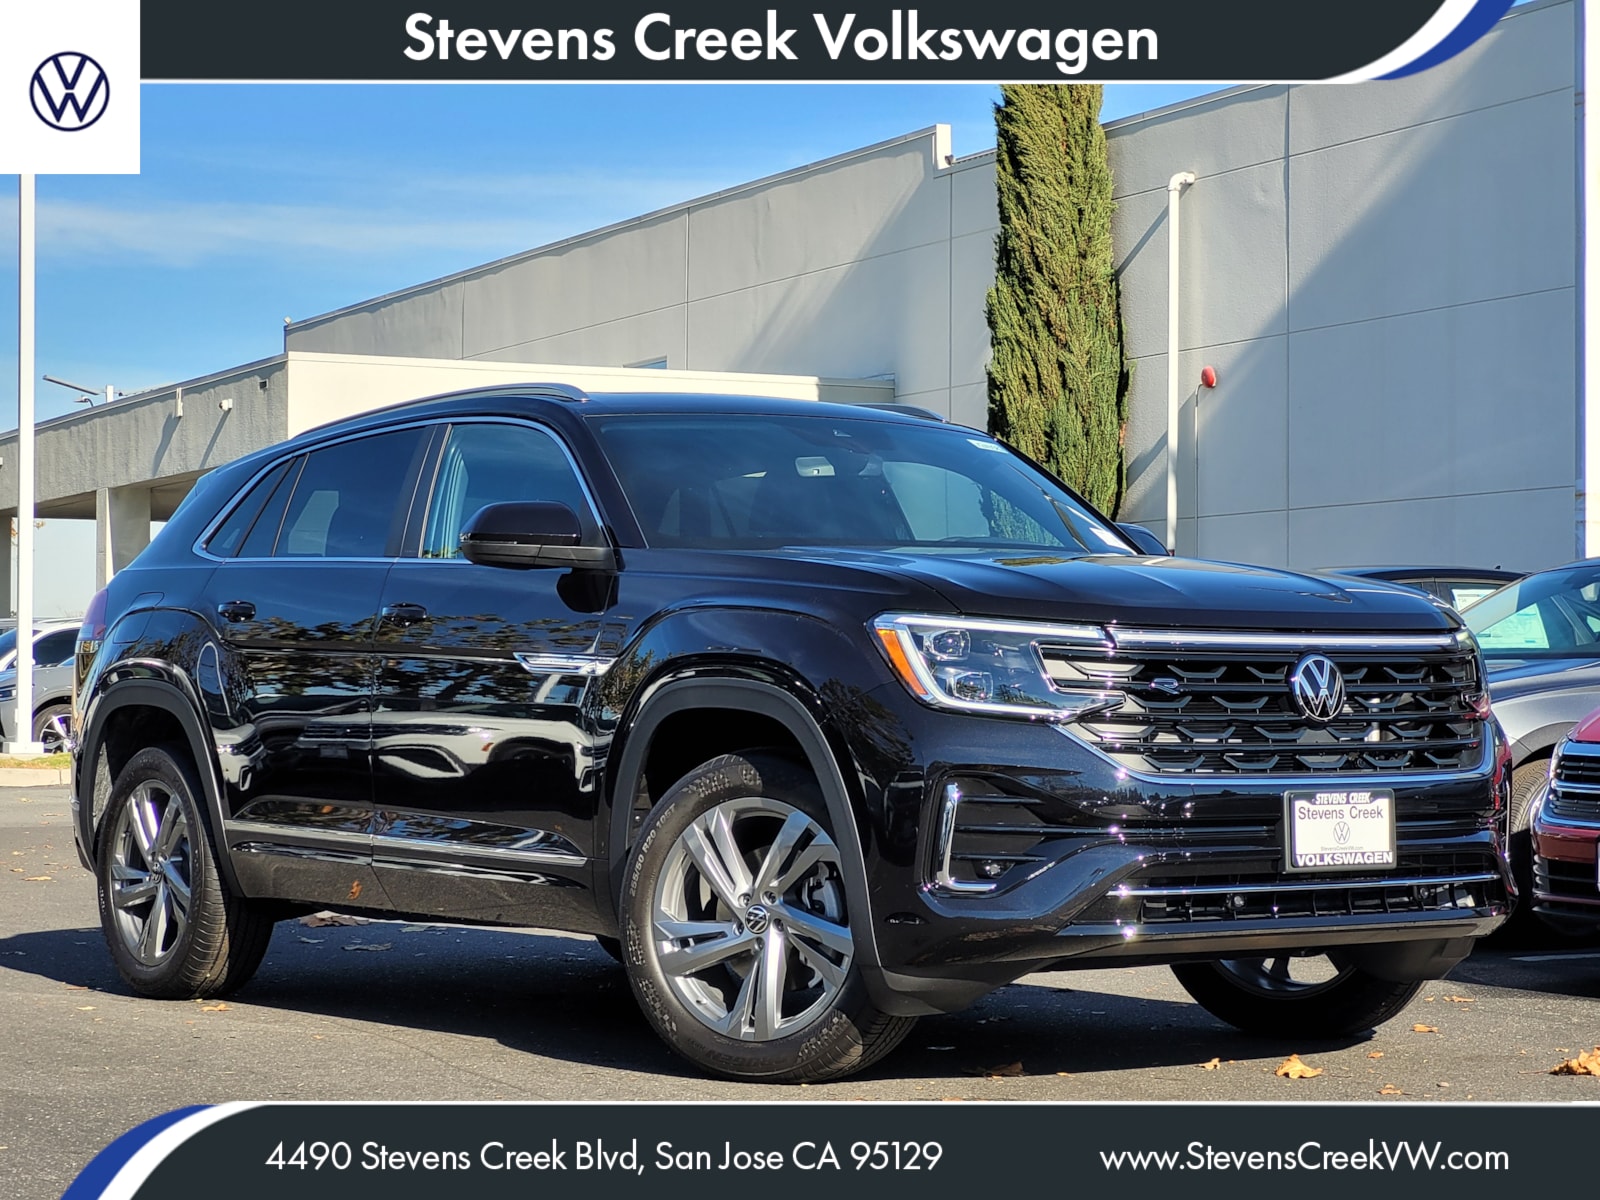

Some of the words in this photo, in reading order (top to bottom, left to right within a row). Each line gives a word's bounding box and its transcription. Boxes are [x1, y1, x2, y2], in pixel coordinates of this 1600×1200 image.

[1315, 793, 1347, 805] STEVENS
[1349, 792, 1372, 804] CREEK
[1298, 806, 1345, 820] Stevens
[1349, 805, 1384, 819] Creek
[642, 829, 657, 854] R20
[1296, 852, 1393, 867] VOLKSWAGEN
